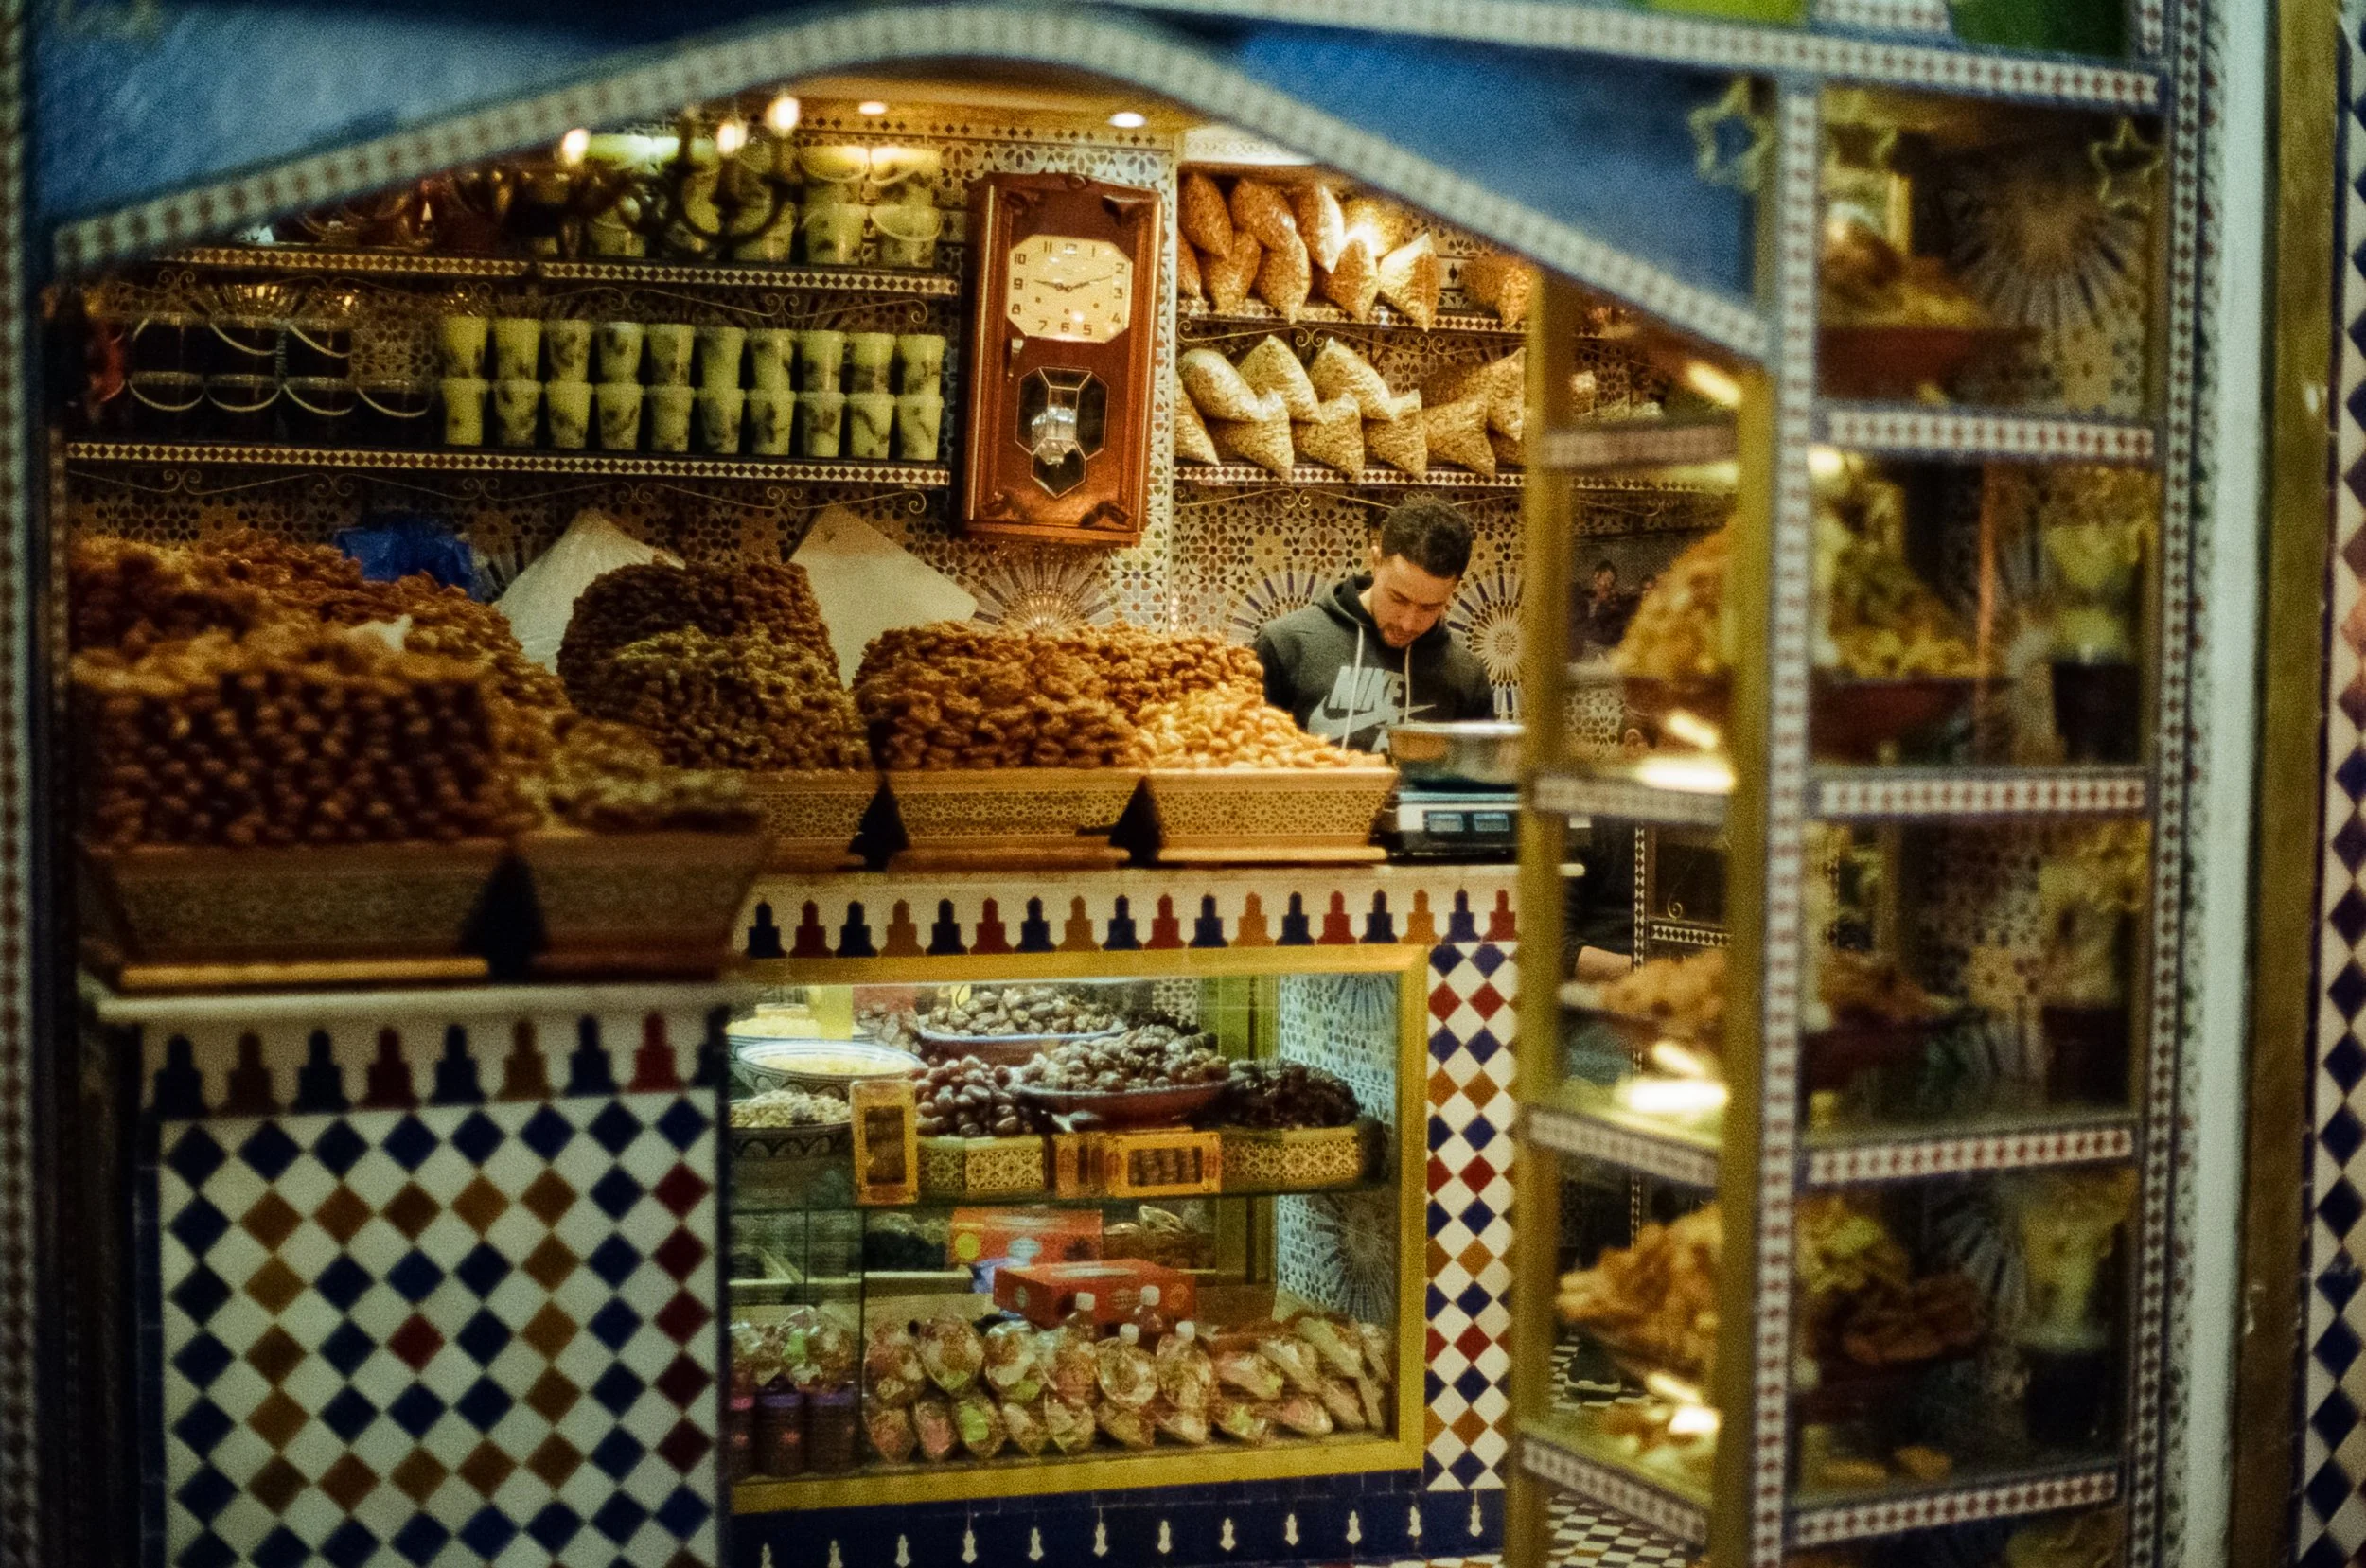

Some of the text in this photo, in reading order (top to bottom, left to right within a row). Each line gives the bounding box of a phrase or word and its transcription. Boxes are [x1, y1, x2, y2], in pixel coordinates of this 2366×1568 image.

[1015, 253, 1027, 265] 10
[1116, 262, 1125, 274] 2
[1014, 278, 1023, 290] 9
[1114, 288, 1123, 299] 3
[1012, 304, 1021, 315] 8
[1111, 312, 1121, 324] 4
[1038, 320, 1048, 331] 7
[1061, 322, 1070, 333] 6
[1083, 324, 1092, 336] 5
[1327, 665, 1406, 712] NIKE
